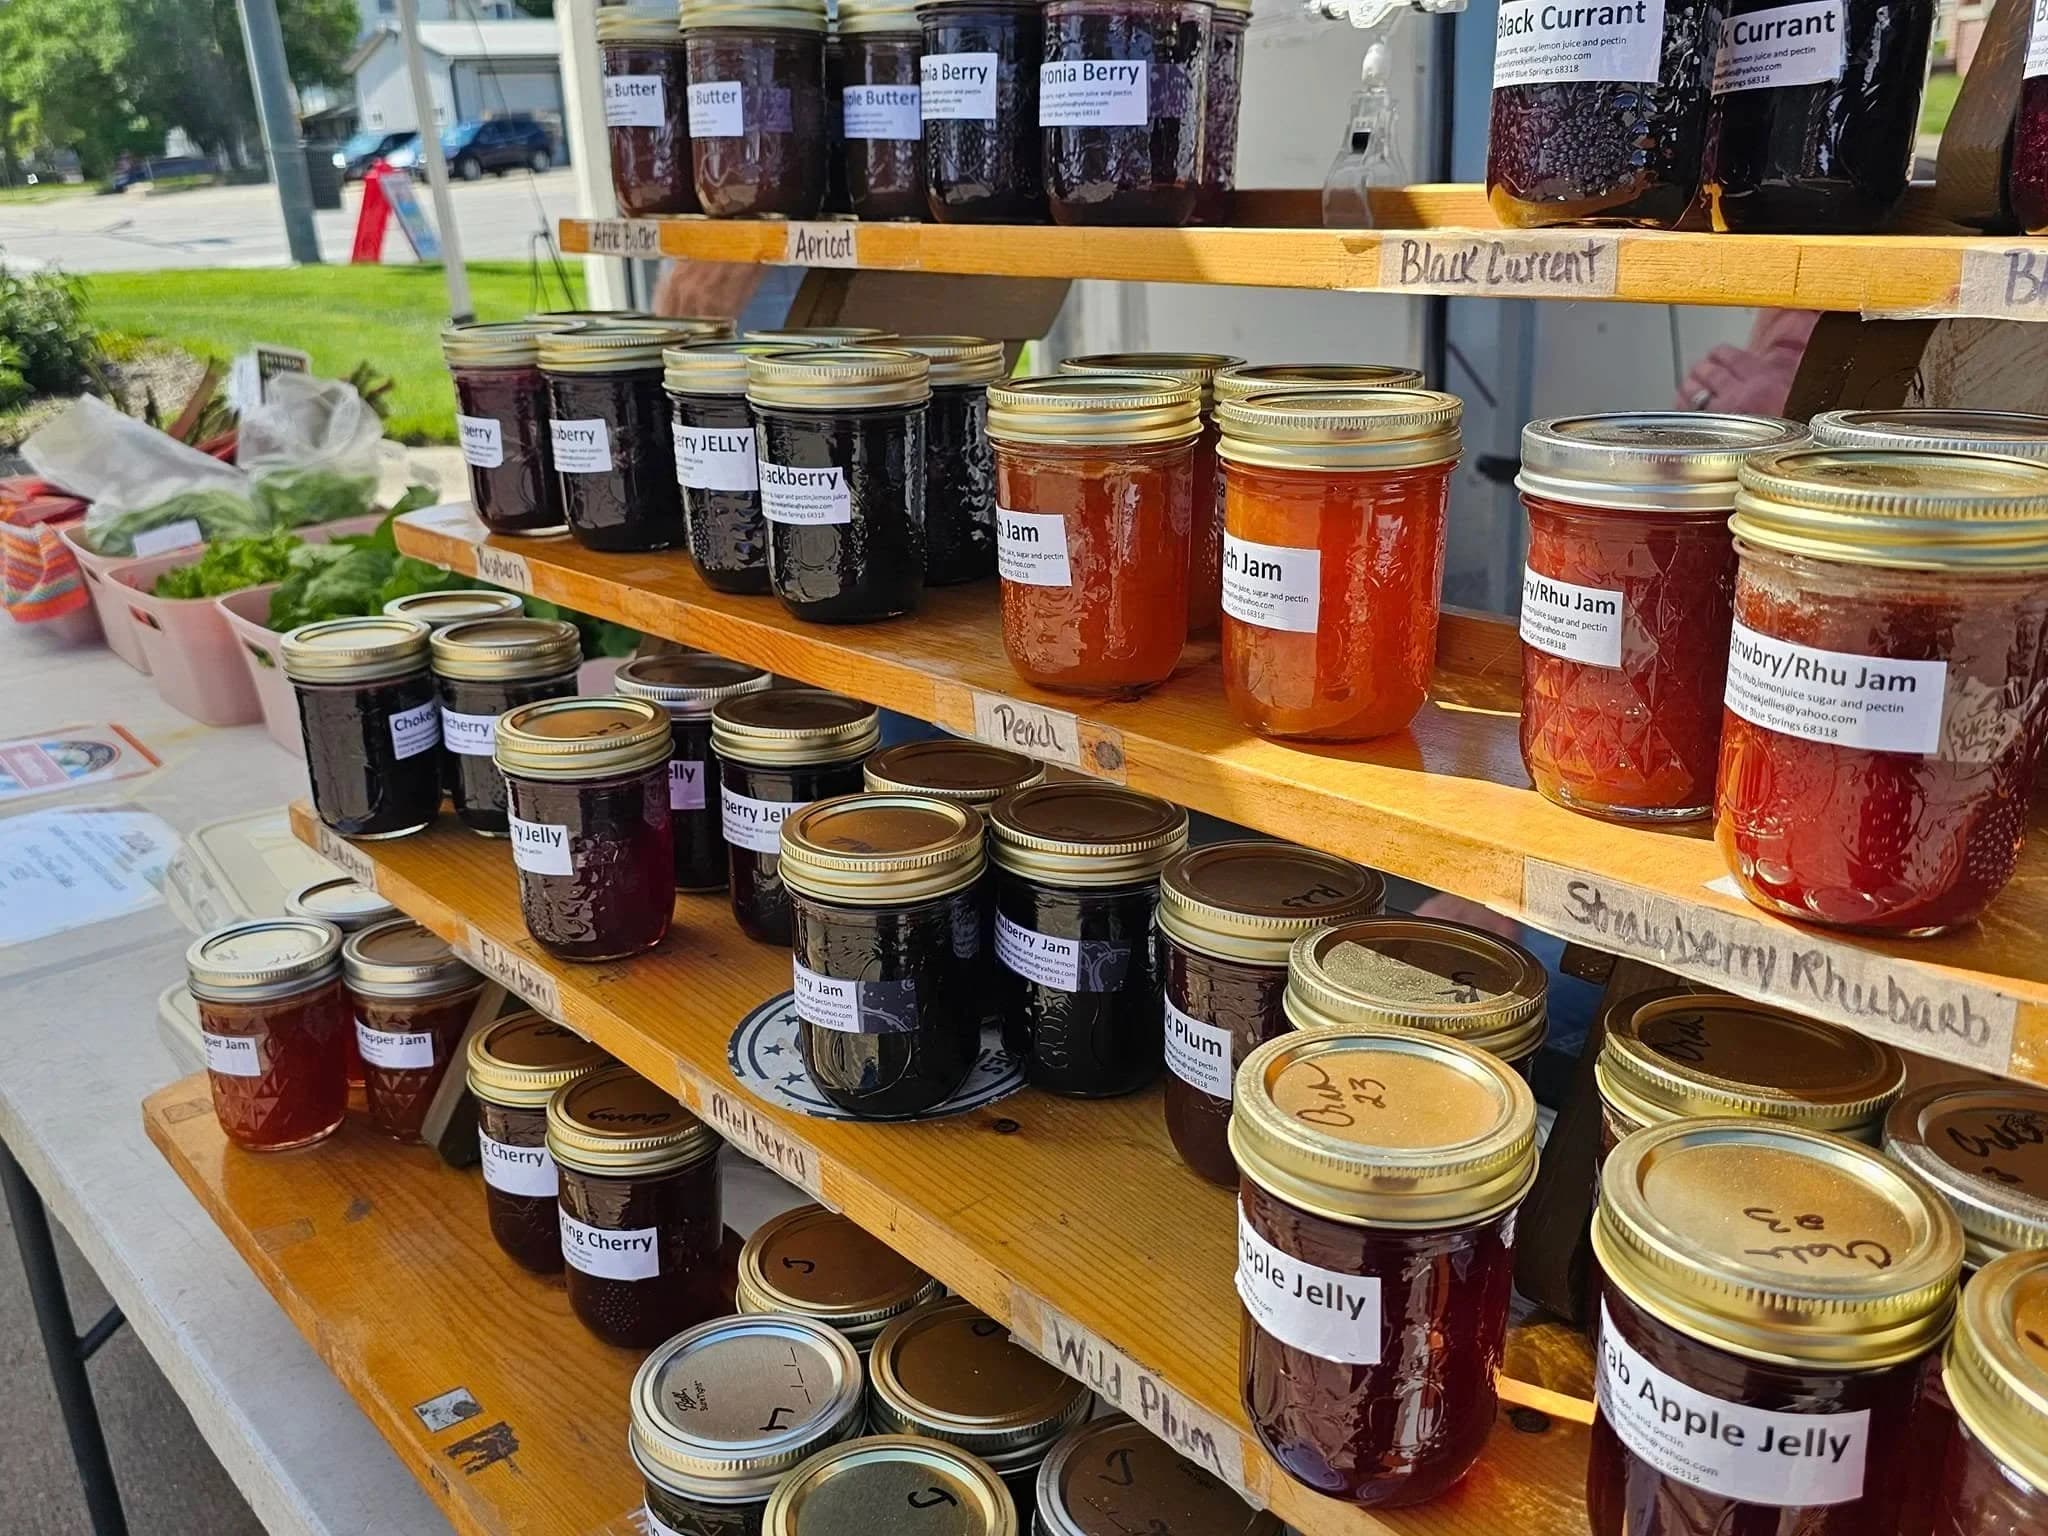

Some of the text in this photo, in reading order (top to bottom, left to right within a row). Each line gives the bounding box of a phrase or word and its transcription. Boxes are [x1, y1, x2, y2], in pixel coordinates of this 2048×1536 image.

[1541, 0, 1647, 30] Currant
[1734, 10, 1836, 46] Currant
[1538, 42, 1560, 50] lemon
[1562, 39, 1581, 50] juice
[1582, 38, 1599, 47] and
[1601, 37, 1627, 49] pectin
[1773, 48, 1789, 57] and
[1790, 46, 1816, 57] pectin
[942, 63, 988, 84] Berry
[1083, 63, 1139, 85] Berry
[1554, 64, 1579, 74] 68318
[615, 83, 657, 98] Butter
[696, 90, 738, 106] Butter
[866, 90, 917, 107] Butter
[795, 229, 852, 261] Apricot
[1400, 238, 1477, 286] Black
[701, 435, 750, 453] JELLY
[1006, 519, 1039, 543] Jam
[1044, 553, 1064, 561] pectin
[1241, 552, 1282, 582] Jam
[1270, 592, 1284, 601] and
[1285, 594, 1309, 604] pectin
[1574, 592, 1616, 616] Jam
[1566, 618, 1580, 628] and
[1581, 622, 1608, 633] pectin
[1546, 637, 1567, 651] 68318
[1855, 666, 1917, 692] Jam
[1807, 694, 1837, 706] sugar
[1840, 700, 1863, 710] and
[1865, 702, 1904, 713] pectin
[993, 703, 1066, 753] Peach
[1767, 713, 1801, 732] Springs
[1802, 723, 1838, 738] 68318
[762, 807, 792, 824] Jell
[526, 825, 562, 848] Jelly
[1562, 880, 1778, 992] Strawberry
[1041, 938, 1071, 956] Jam
[818, 981, 843, 998] Jam
[225, 1039, 250, 1051] Jam
[399, 1033, 427, 1047] Jam
[1175, 1018, 1222, 1058] Plum
[491, 1143, 545, 1168] Cherry
[588, 1232, 653, 1252] Cherry
[1292, 1273, 1367, 1321] Jelly
[1053, 1318, 1228, 1480] Wild Plum
[1639, 1375, 1746, 1449] Apple
[1758, 1426, 1852, 1464] Jelly
[1665, 1462, 1701, 1485] 68318
